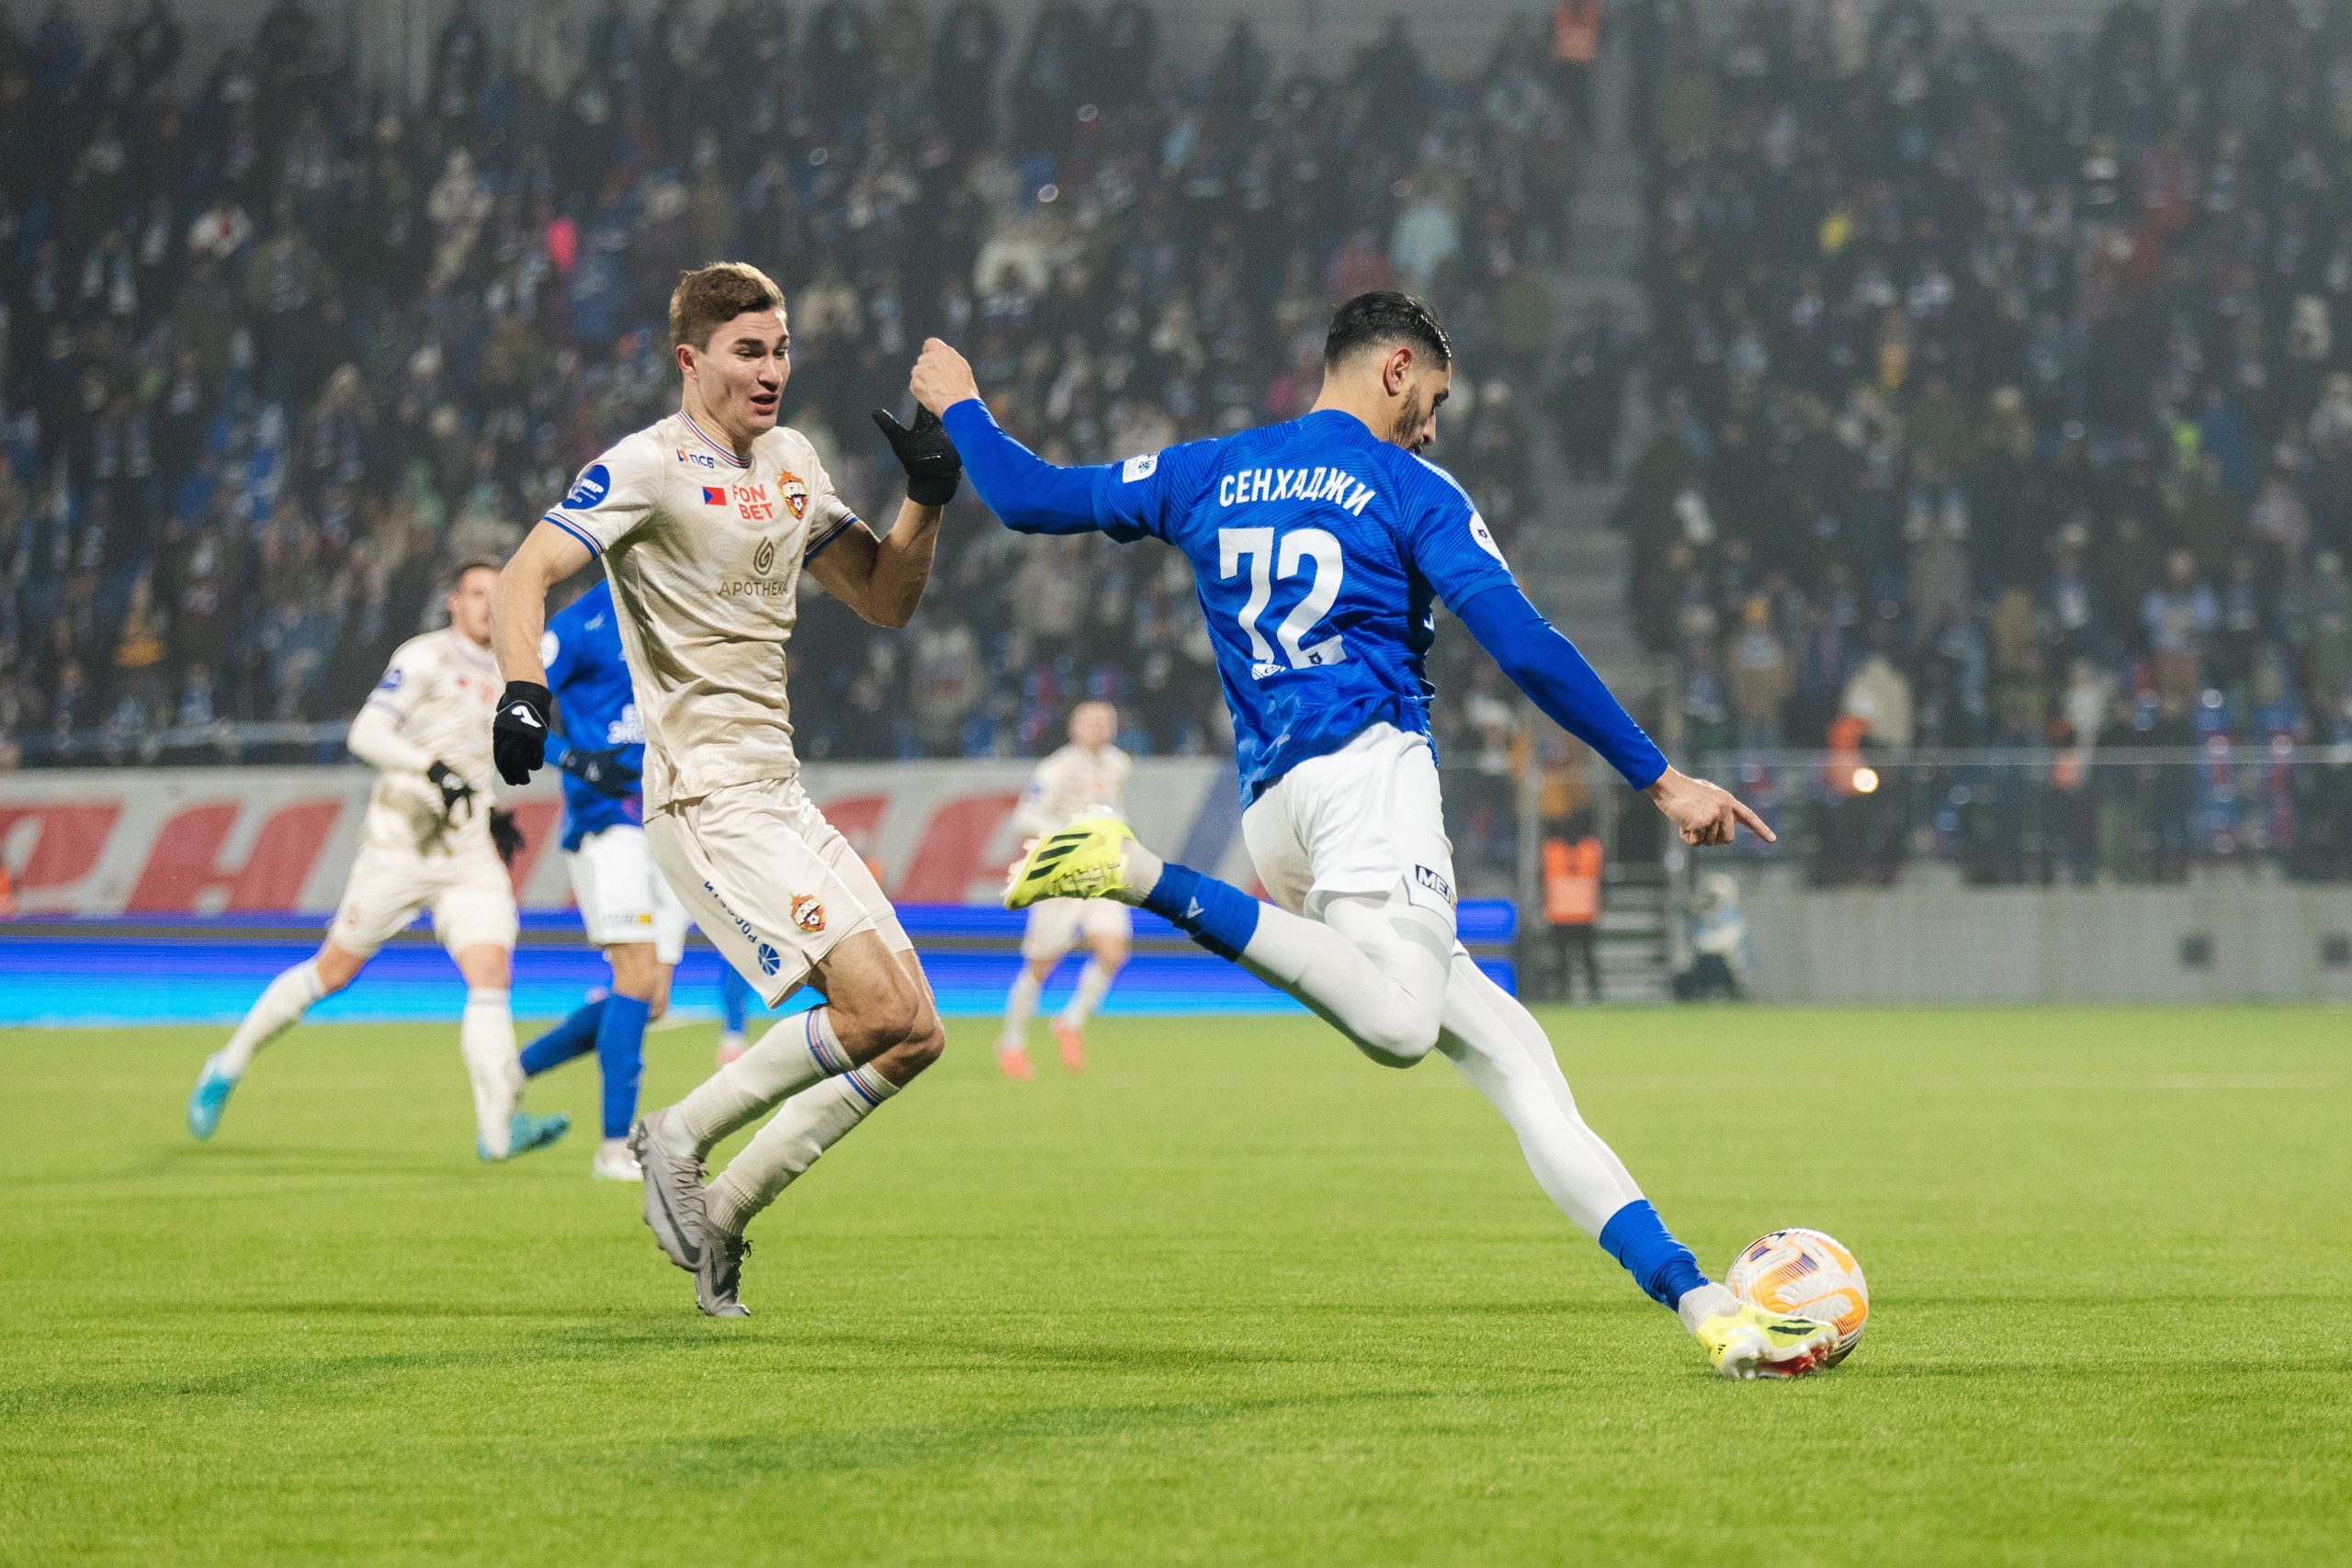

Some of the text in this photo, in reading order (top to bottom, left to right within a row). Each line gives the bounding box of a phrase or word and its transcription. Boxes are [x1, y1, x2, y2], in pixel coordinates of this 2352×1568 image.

[689, 453, 715, 469] ПСБ
[732, 483, 767, 503] FON
[1219, 467, 1376, 517] СЕНХАДЖИ
[738, 502, 774, 521] BET
[1218, 526, 1348, 670] 72
